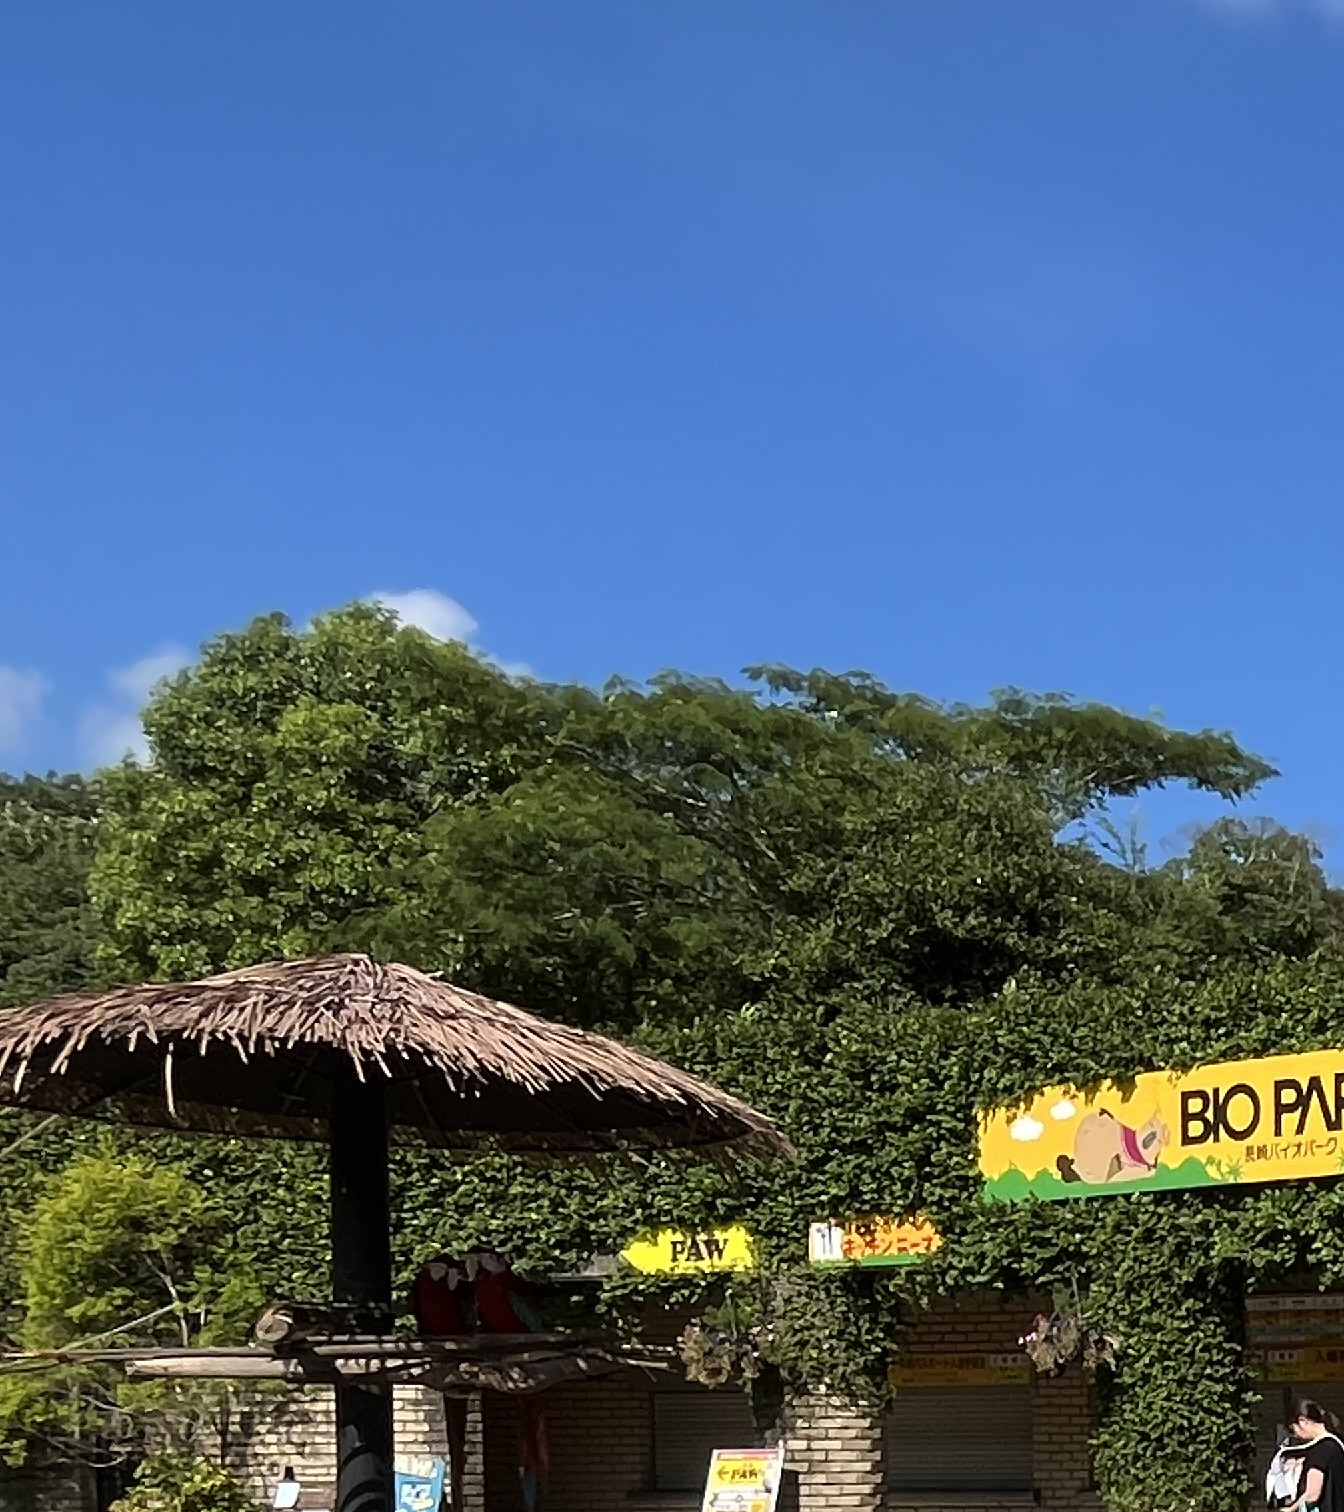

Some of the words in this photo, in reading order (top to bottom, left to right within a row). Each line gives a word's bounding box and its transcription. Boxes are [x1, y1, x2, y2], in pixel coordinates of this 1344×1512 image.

[1180, 1083, 1261, 1147] BIO
[1245, 1137, 1338, 1163] 長崎バイオパーク
[671, 1236, 729, 1262] PAW
